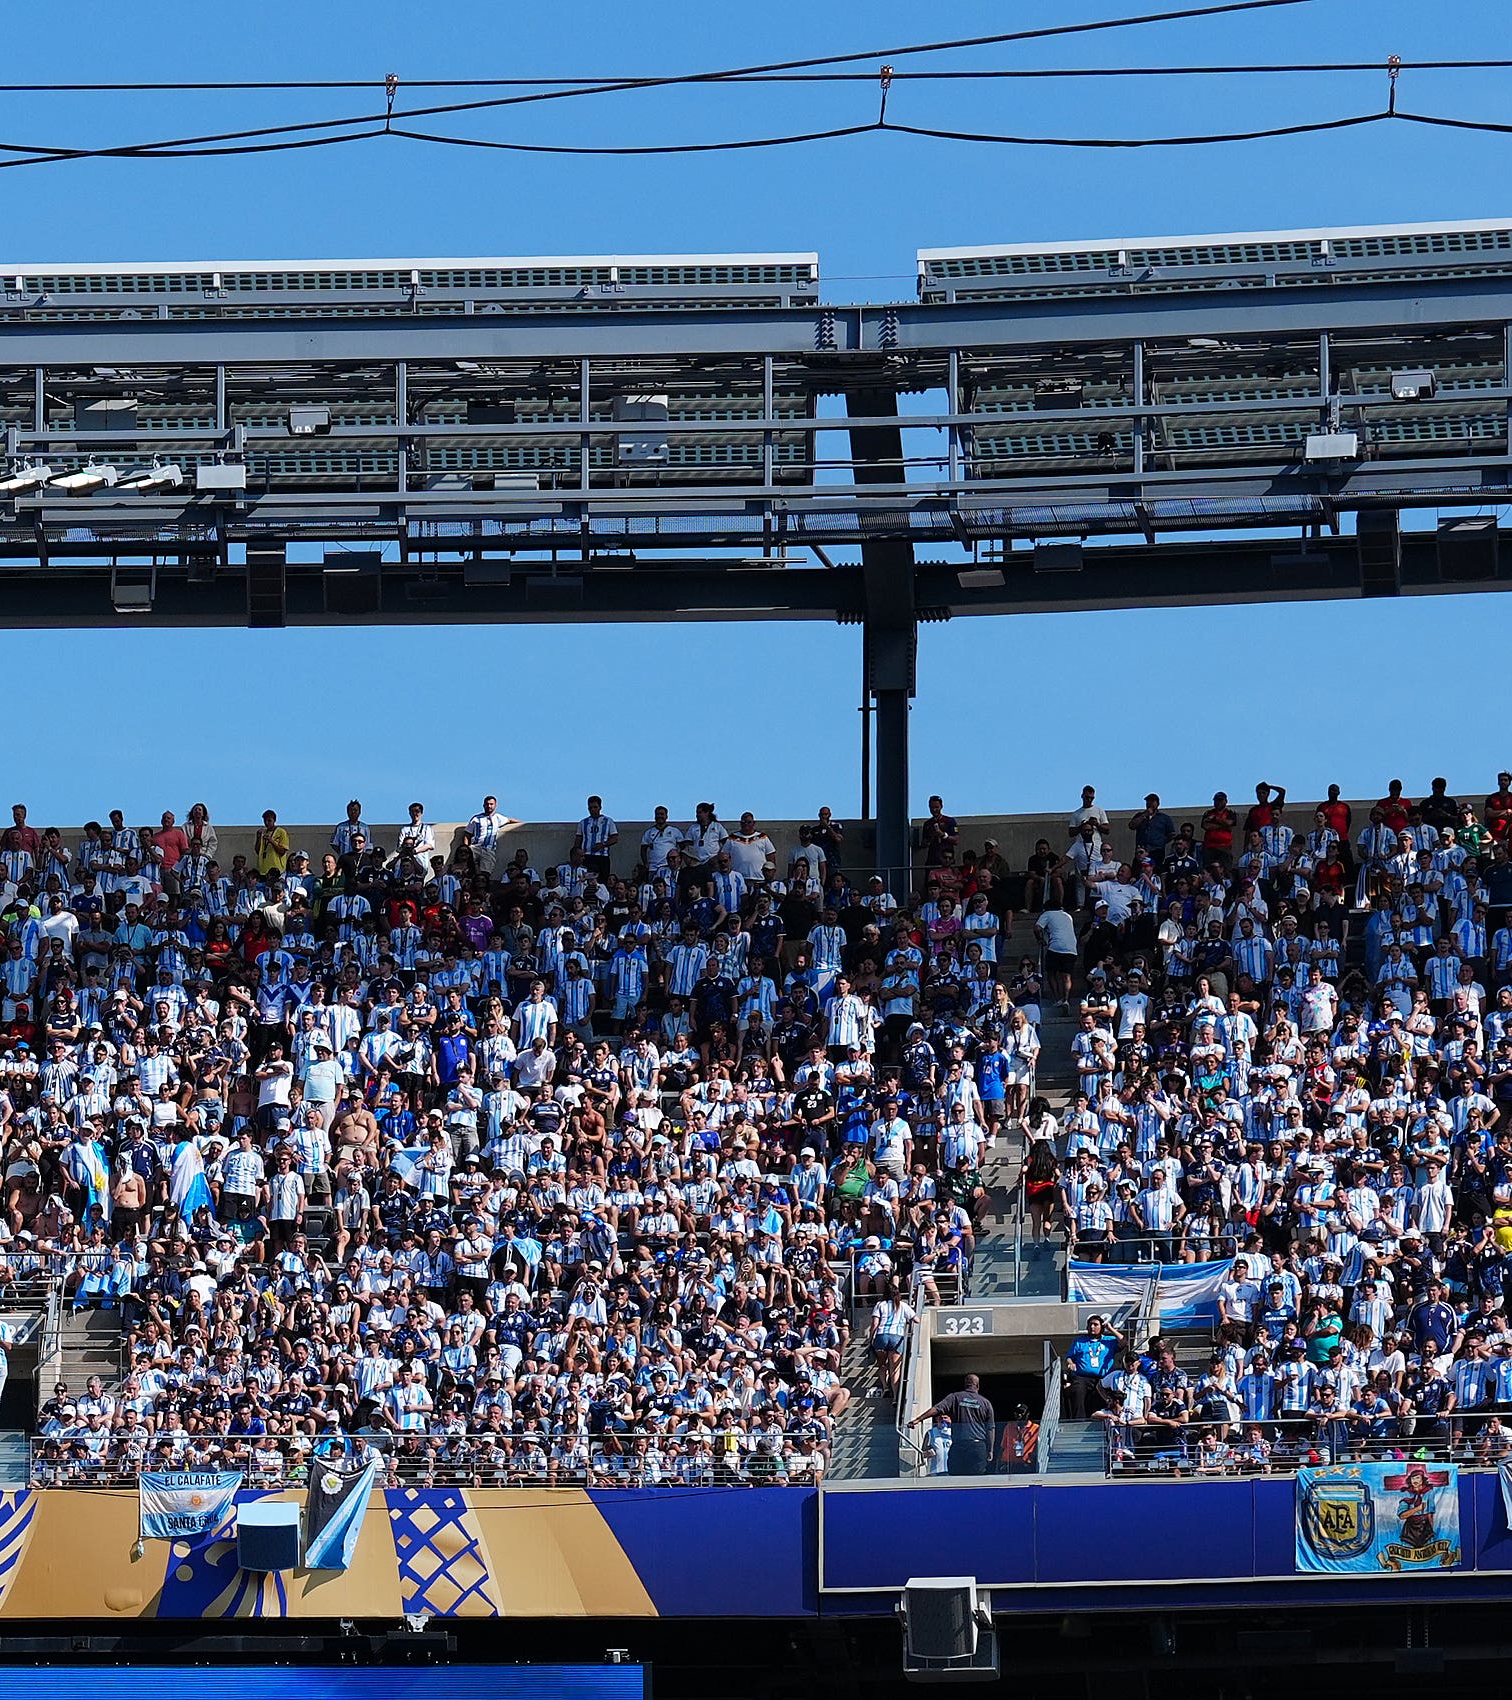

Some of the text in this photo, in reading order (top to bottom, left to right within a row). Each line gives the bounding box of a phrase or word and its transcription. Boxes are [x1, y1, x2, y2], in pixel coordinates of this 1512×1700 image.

[806, 1100, 817, 1108] 23
[945, 1317, 985, 1335] 323
[164, 1474, 221, 1487] EL CALAFATE
[167, 1516, 196, 1530] SANTA
